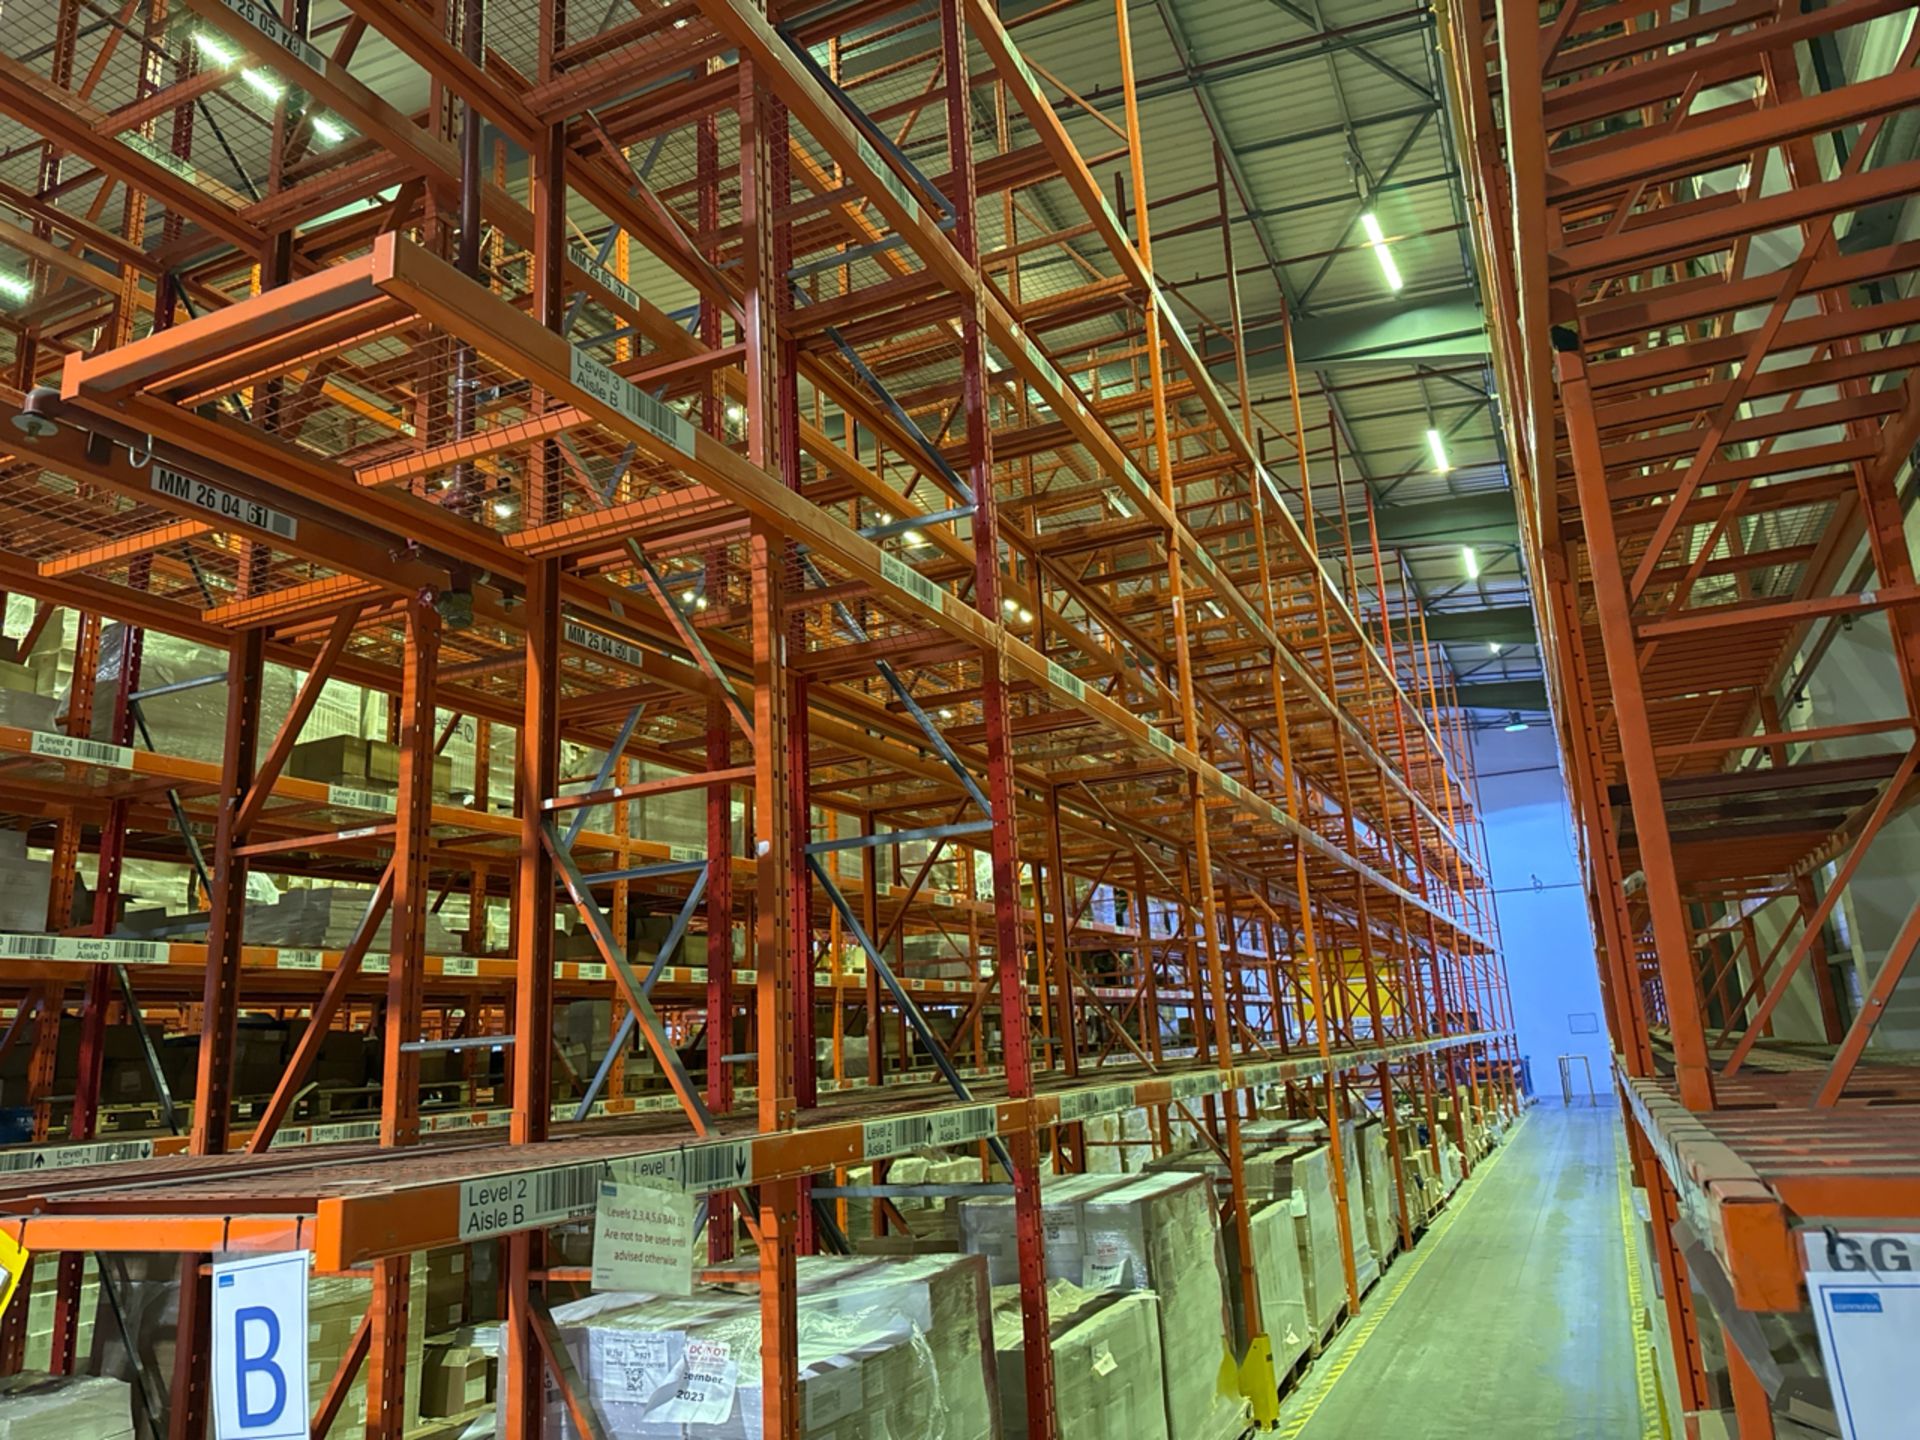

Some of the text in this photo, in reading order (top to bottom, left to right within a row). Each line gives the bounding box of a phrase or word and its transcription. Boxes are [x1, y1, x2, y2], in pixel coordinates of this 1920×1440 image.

[237, 0, 255, 21] 26
[259, 15, 276, 38] 05
[576, 351, 621, 392] Level 3
[576, 371, 619, 408] Aisle B
[158, 469, 191, 499] MM
[196, 485, 216, 509] 26
[221, 494, 240, 518] 04
[568, 625, 586, 645] MM
[588, 632, 600, 650] 25
[601, 637, 613, 656] 04
[37, 745, 72, 757] Aisle D
[38, 734, 73, 748] Level 4
[75, 950, 109, 961] Aisle D
[77, 941, 111, 950] Level 3
[56, 1147, 91, 1159] Level 1
[633, 1154, 676, 1178] Level 1
[468, 1178, 528, 1208] Level 2
[466, 1204, 525, 1234] Aisle B
[607, 1207, 631, 1220] Levels
[604, 1228, 619, 1240] Are
[620, 1230, 634, 1241] not
[635, 1231, 643, 1243] to
[644, 1232, 654, 1244] be
[655, 1234, 671, 1247] used
[614, 1250, 678, 1266] advised otherwise
[1826, 1238, 1912, 1272] GG
[234, 1305, 287, 1428] B
[676, 1389, 705, 1403] 2023
